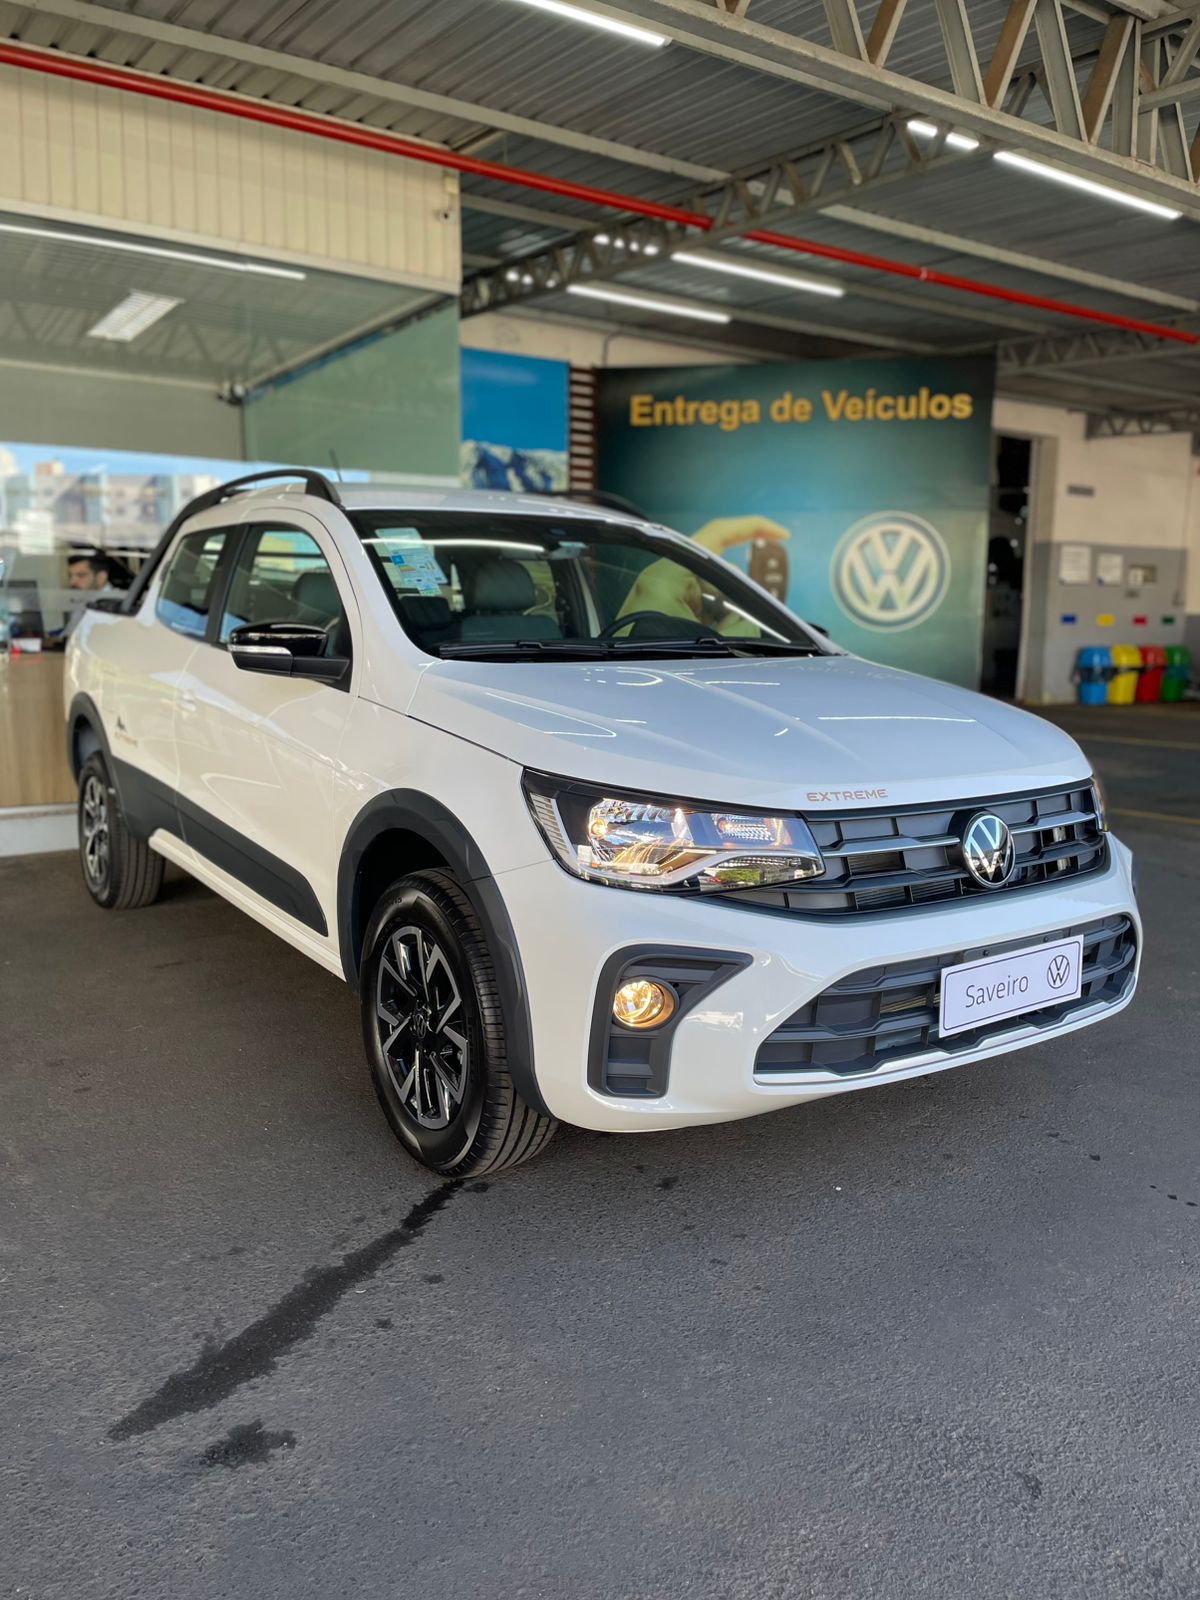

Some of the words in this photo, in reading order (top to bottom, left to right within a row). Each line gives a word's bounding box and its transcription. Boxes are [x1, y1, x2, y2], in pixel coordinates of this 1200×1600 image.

[629, 395, 760, 431] Entrega
[769, 392, 812, 422] de
[821, 387, 974, 422] Veículos
[841, 523, 943, 622] VW
[806, 788, 888, 802] EXTREME
[1047, 954, 1070, 989] VW
[965, 975, 1029, 1008] Saveiro
